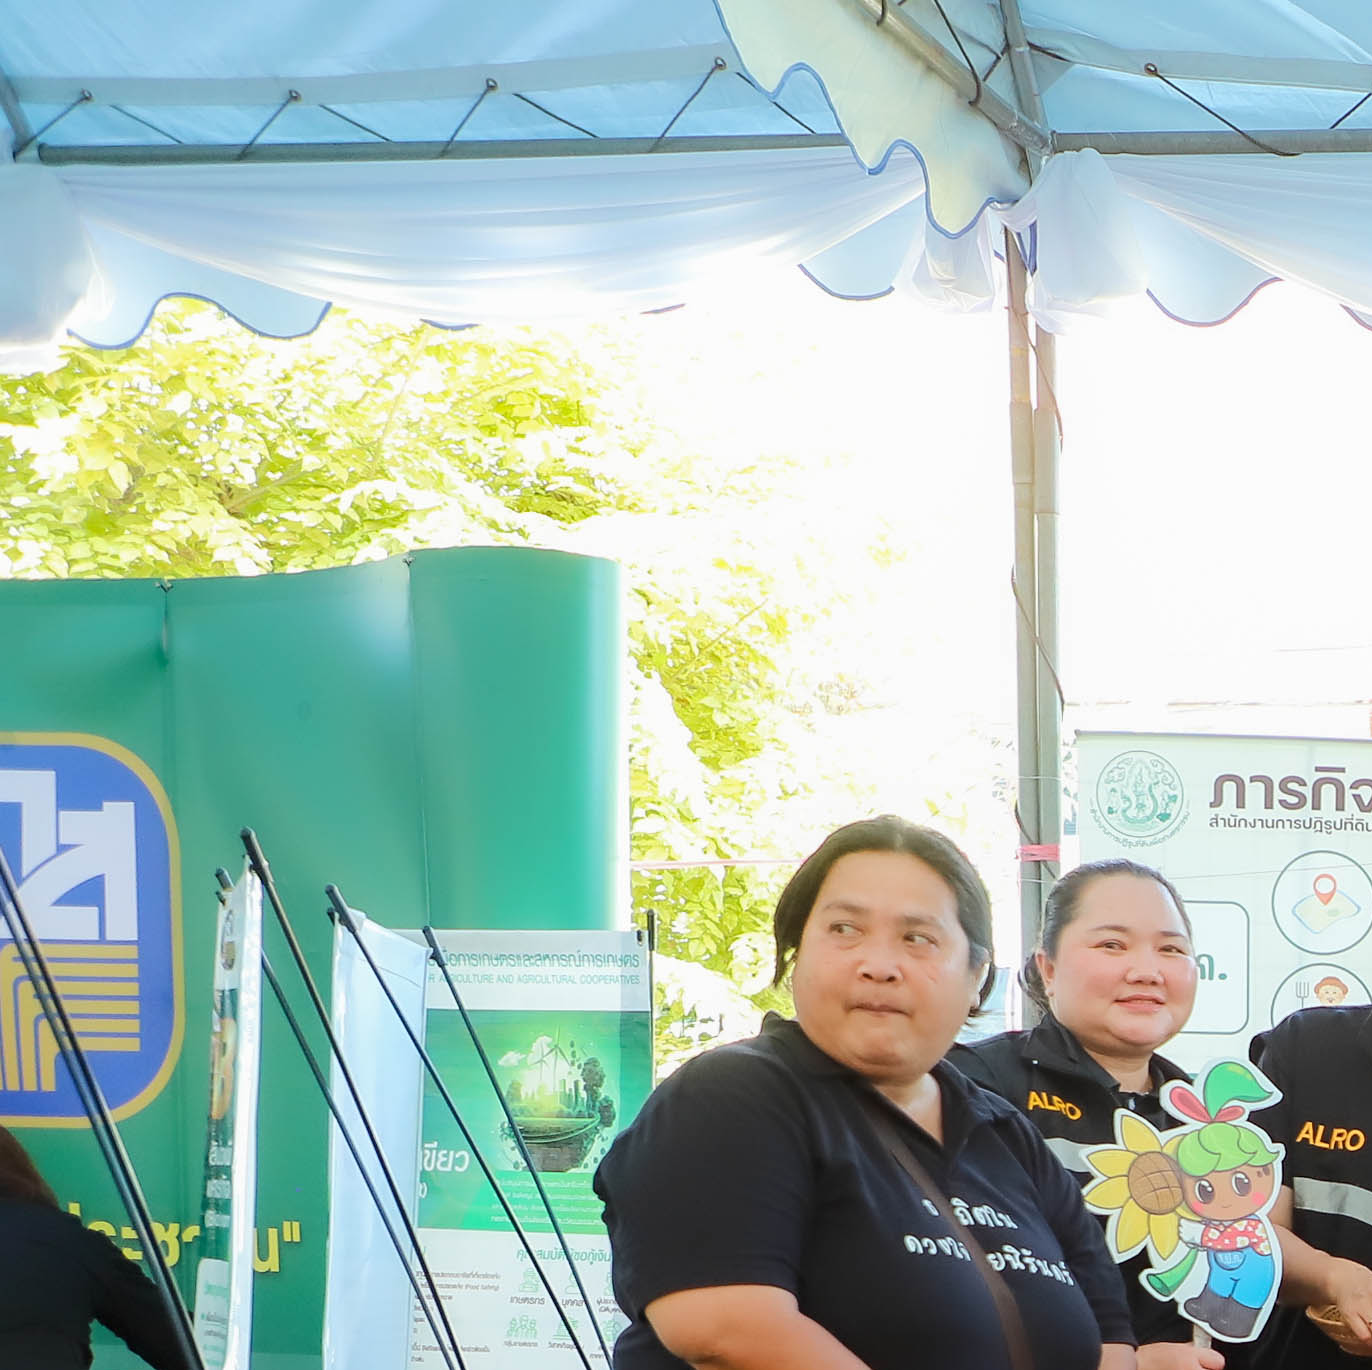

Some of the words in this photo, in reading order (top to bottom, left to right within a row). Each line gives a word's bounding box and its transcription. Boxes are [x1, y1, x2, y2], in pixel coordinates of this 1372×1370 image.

[497, 975, 514, 983] AND
[581, 975, 640, 985] COOPERATIVES
[1027, 1090, 1082, 1121] ALRO
[1296, 1121, 1366, 1152] ALRO
[950, 1197, 1019, 1230] ถิตใน
